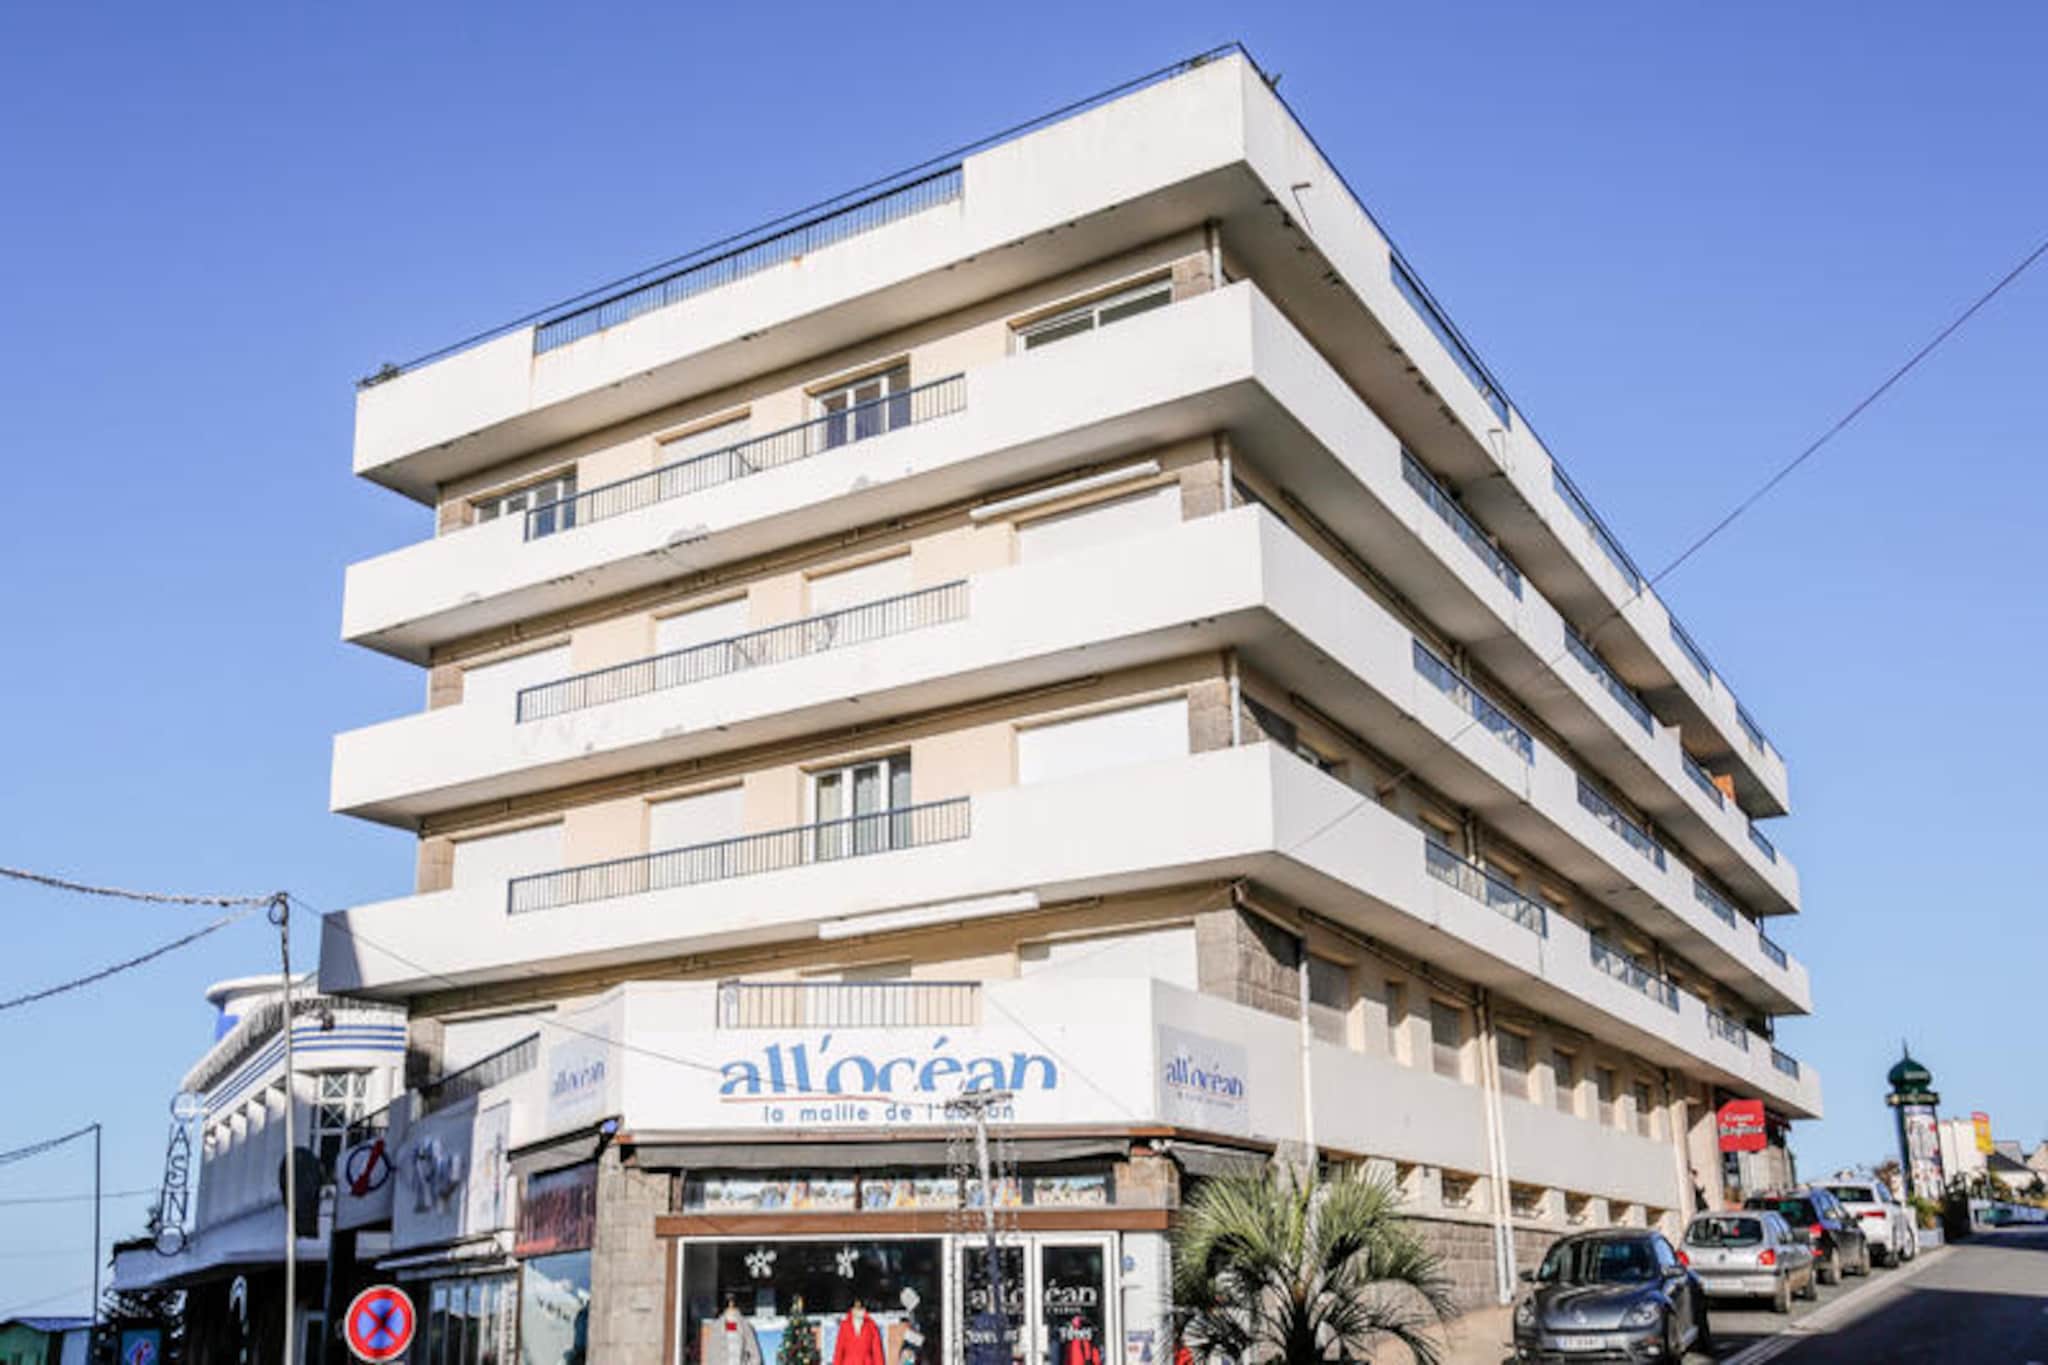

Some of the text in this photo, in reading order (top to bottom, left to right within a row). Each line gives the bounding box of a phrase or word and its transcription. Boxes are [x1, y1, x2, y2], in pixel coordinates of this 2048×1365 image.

[719, 1033, 1058, 1095] all'océan
[1166, 1057, 1243, 1097] all'océan
[764, 1105, 783, 1123] la
[800, 1103, 869, 1121] maille
[886, 1101, 913, 1121] de
